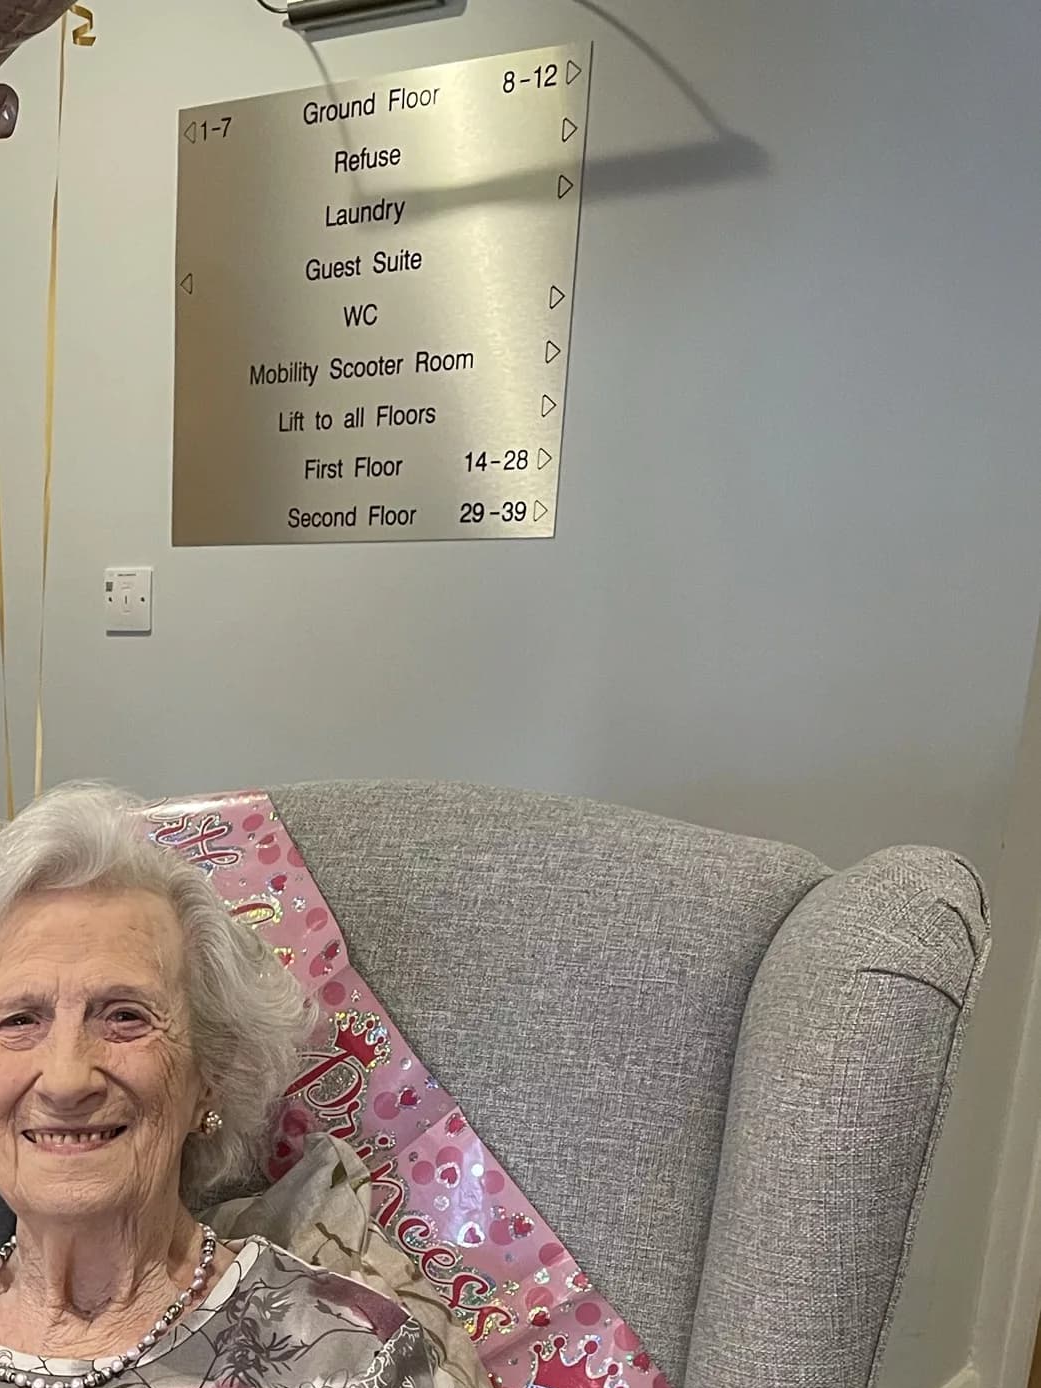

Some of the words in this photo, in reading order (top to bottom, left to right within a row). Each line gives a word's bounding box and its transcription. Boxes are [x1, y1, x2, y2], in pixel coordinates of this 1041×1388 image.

[200, 116, 232, 142] 1-7
[303, 91, 376, 126] Ground
[388, 87, 441, 112] Floor
[502, 63, 558, 94] 8-12
[334, 146, 402, 174] Refuse
[325, 197, 406, 228] Laundry
[305, 255, 362, 282] Guest
[372, 248, 423, 274] Suite
[343, 303, 379, 328] WC
[249, 360, 319, 388] Mobility
[329, 355, 405, 380] Scooter
[415, 350, 475, 374] Room
[278, 410, 305, 433] Lift
[314, 410, 333, 431] to
[343, 406, 365, 429] all
[376, 404, 437, 428] Floors
[304, 458, 344, 480] First
[354, 456, 404, 478] Floor
[464, 449, 530, 473] 14-28
[287, 505, 358, 529] Second
[368, 504, 418, 527] Floor
[459, 500, 528, 524] 29-39
